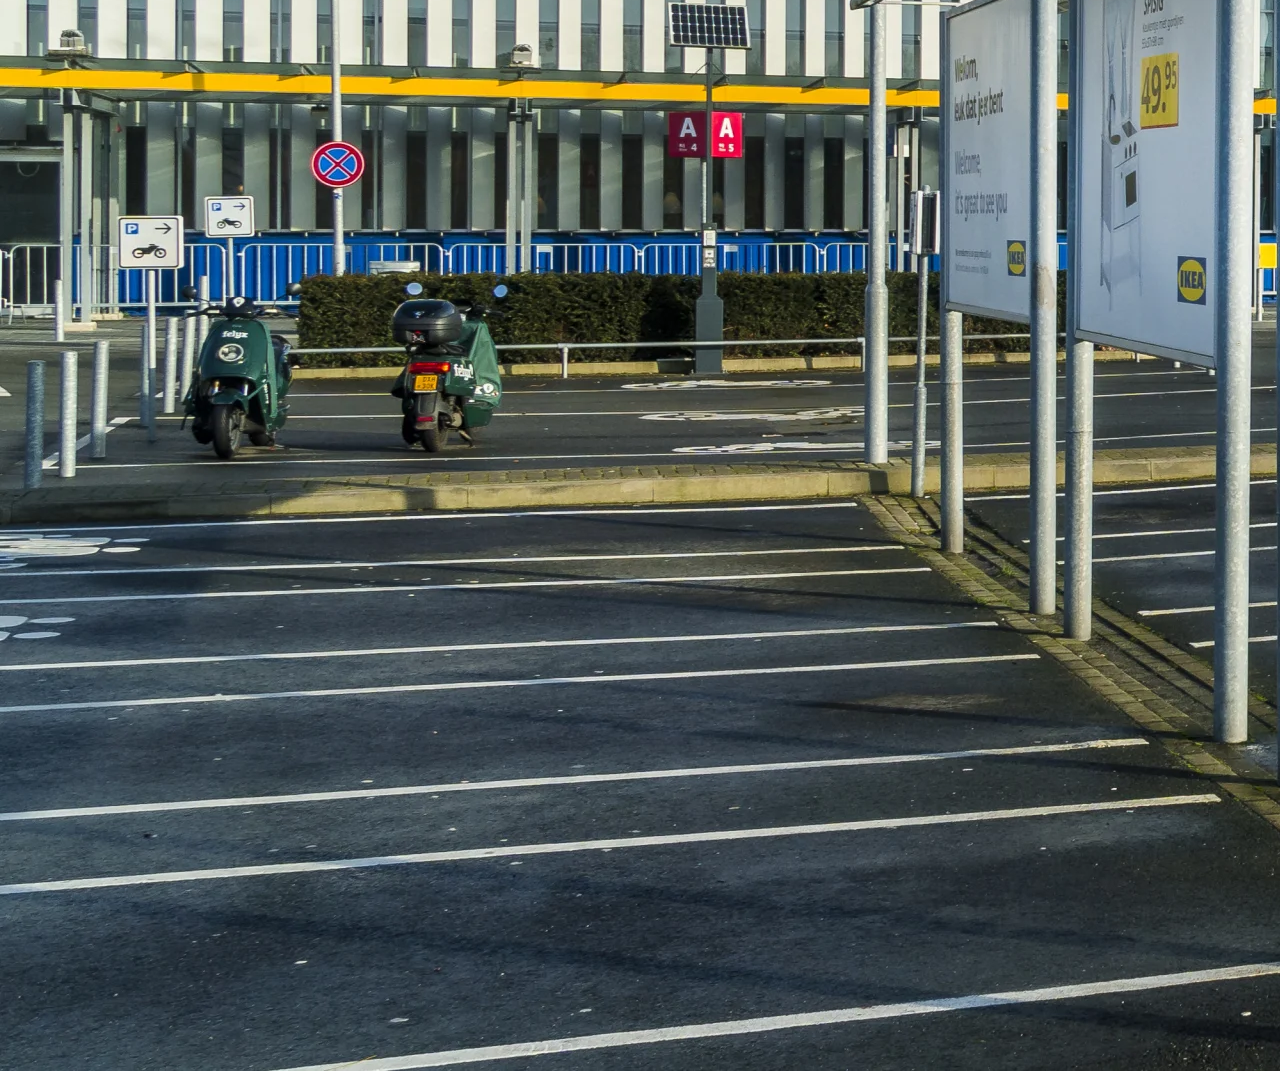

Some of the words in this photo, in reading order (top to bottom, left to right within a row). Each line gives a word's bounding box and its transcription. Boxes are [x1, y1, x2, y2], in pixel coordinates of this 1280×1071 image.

[679, 118, 697, 137] A
[719, 118, 734, 138] A
[691, 143, 697, 151] 4
[728, 143, 734, 152] 5
[127, 225, 137, 233] P
[1180, 270, 1204, 289] IKEA
